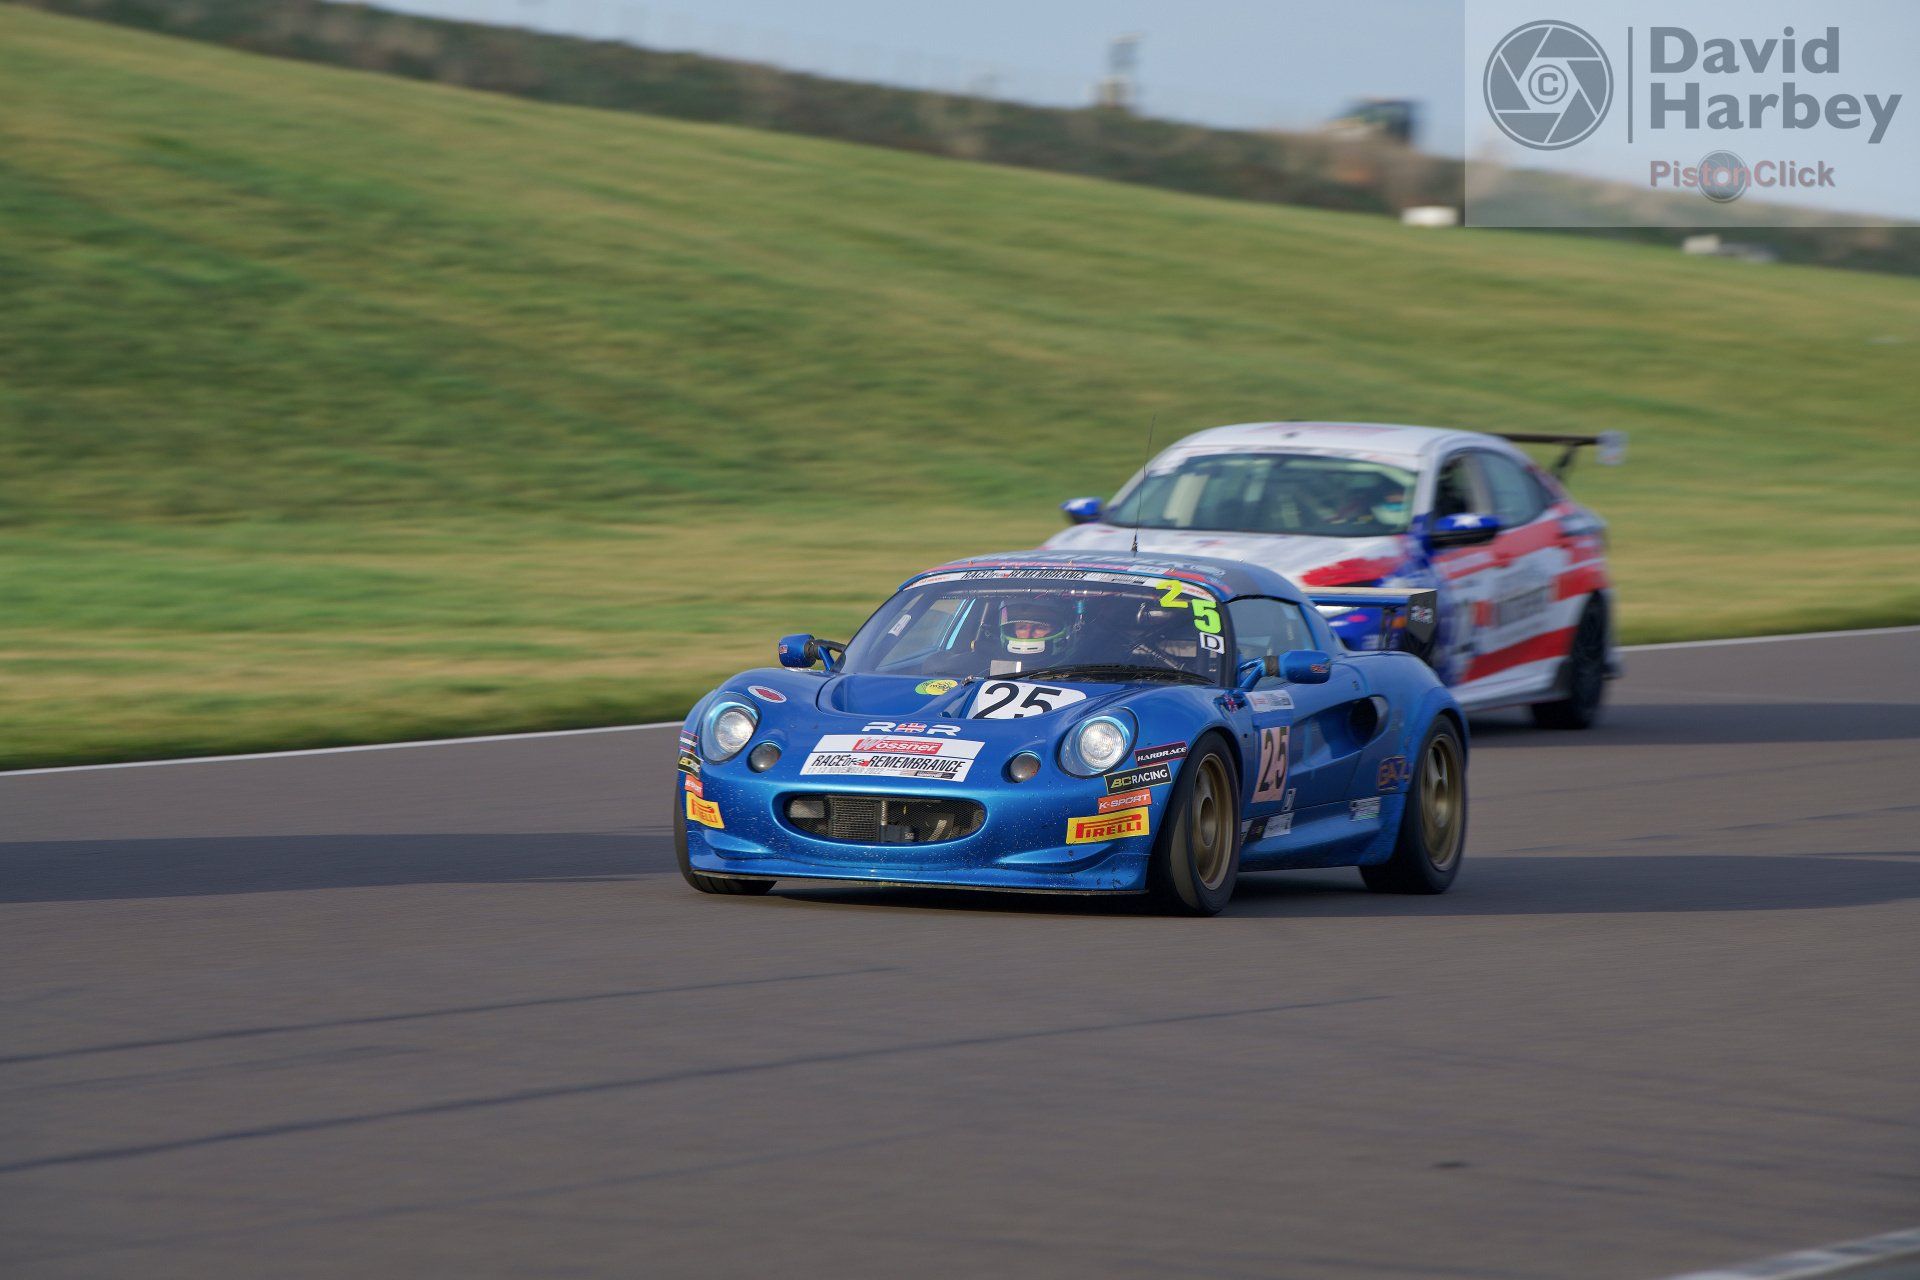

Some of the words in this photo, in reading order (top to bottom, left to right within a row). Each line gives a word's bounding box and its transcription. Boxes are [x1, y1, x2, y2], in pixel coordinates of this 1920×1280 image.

[1205, 636, 1221, 650] D
[972, 682, 1062, 719] 25
[811, 754, 847, 767] RACE
[869, 755, 965, 772] REMEMBRANCE
[1137, 747, 1187, 762] HARDRACE
[1258, 726, 1288, 793] 25
[1099, 793, 1150, 810] K-SPORT
[1075, 814, 1142, 839] PIRELLI
